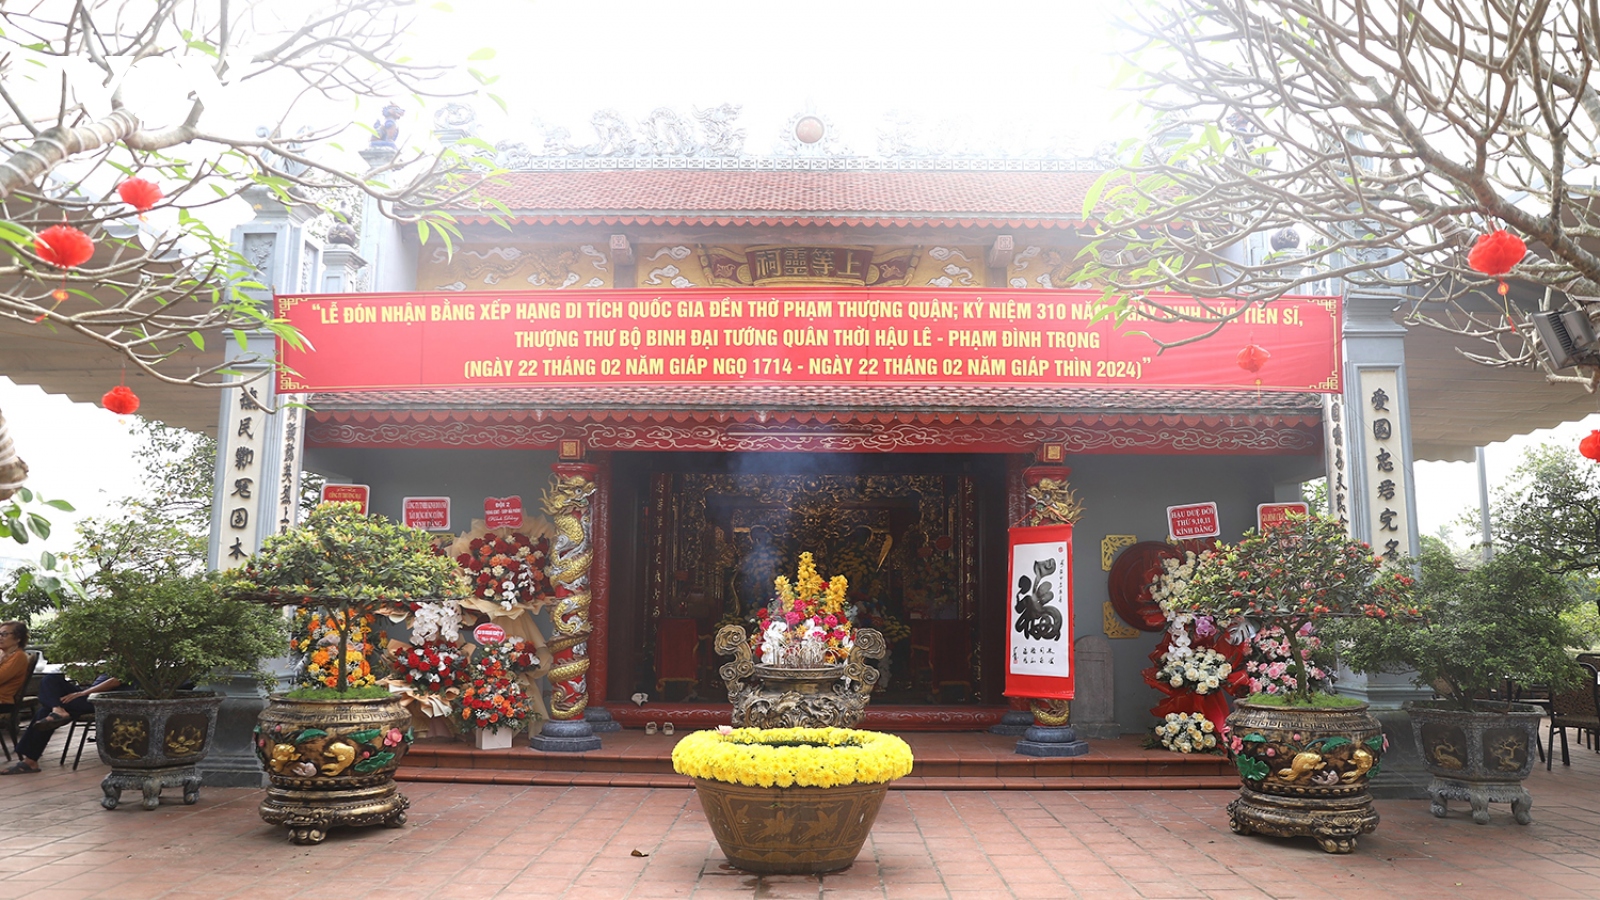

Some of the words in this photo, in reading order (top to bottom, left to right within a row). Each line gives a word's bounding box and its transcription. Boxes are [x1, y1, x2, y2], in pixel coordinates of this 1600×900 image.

[343, 304, 376, 323] ĐÓN
[381, 302, 426, 325] NHẬN
[431, 299, 475, 321] BẰNG
[480, 299, 511, 320] XẾP
[516, 302, 560, 323] HẠNG
[566, 302, 581, 318] DI
[587, 300, 622, 318] TÍCH
[628, 298, 671, 319] QUỐC
[677, 301, 704, 317] GIA
[709, 297, 742, 317] ĐỀN
[748, 298, 779, 317] THỜ
[784, 301, 832, 321] PHẠM
[838, 300, 902, 321] THƯỢNG
[908, 298, 958, 322] QUẬN;
[964, 297, 984, 319] KỶ
[990, 299, 1031, 322] NIỆM
[1036, 303, 1066, 319] 310
[1114, 301, 1157, 322] GÀY
[1282, 305, 1303, 327] SĨ,
[515, 329, 578, 351] THƯỢNG
[584, 329, 616, 346] THƯ
[620, 327, 641, 350] BỘ
[647, 330, 685, 346] BINH
[691, 330, 718, 349] ĐẠI
[724, 326, 777, 346] TƯỚNG
[783, 326, 828, 348] QUÂN
[834, 326, 869, 346] THỜI
[875, 327, 908, 350] HẬU
[914, 327, 932, 347] LÊ
[949, 330, 997, 350] PHẠM
[1002, 328, 1041, 348] ĐÌNH
[1046, 331, 1100, 352] TRỌNG
[465, 357, 513, 378] (NGÀY
[518, 360, 538, 376] 22
[543, 356, 595, 376] THÁNG
[601, 359, 620, 375] 02
[626, 355, 663, 375] NĂM
[670, 355, 707, 375] GIÁP
[713, 358, 747, 378] NGỌ
[753, 358, 792, 375] 1714
[809, 355, 853, 375] NGÀY
[859, 359, 878, 375] 22
[884, 355, 937, 375] THÁNG
[943, 359, 962, 375] 02
[968, 355, 1005, 376] NĂM
[1012, 357, 1049, 376] GIÁP
[1054, 357, 1091, 377] THÌN
[1176, 527, 1193, 535] KÍNH
[1194, 524, 1213, 533] DÂNG
